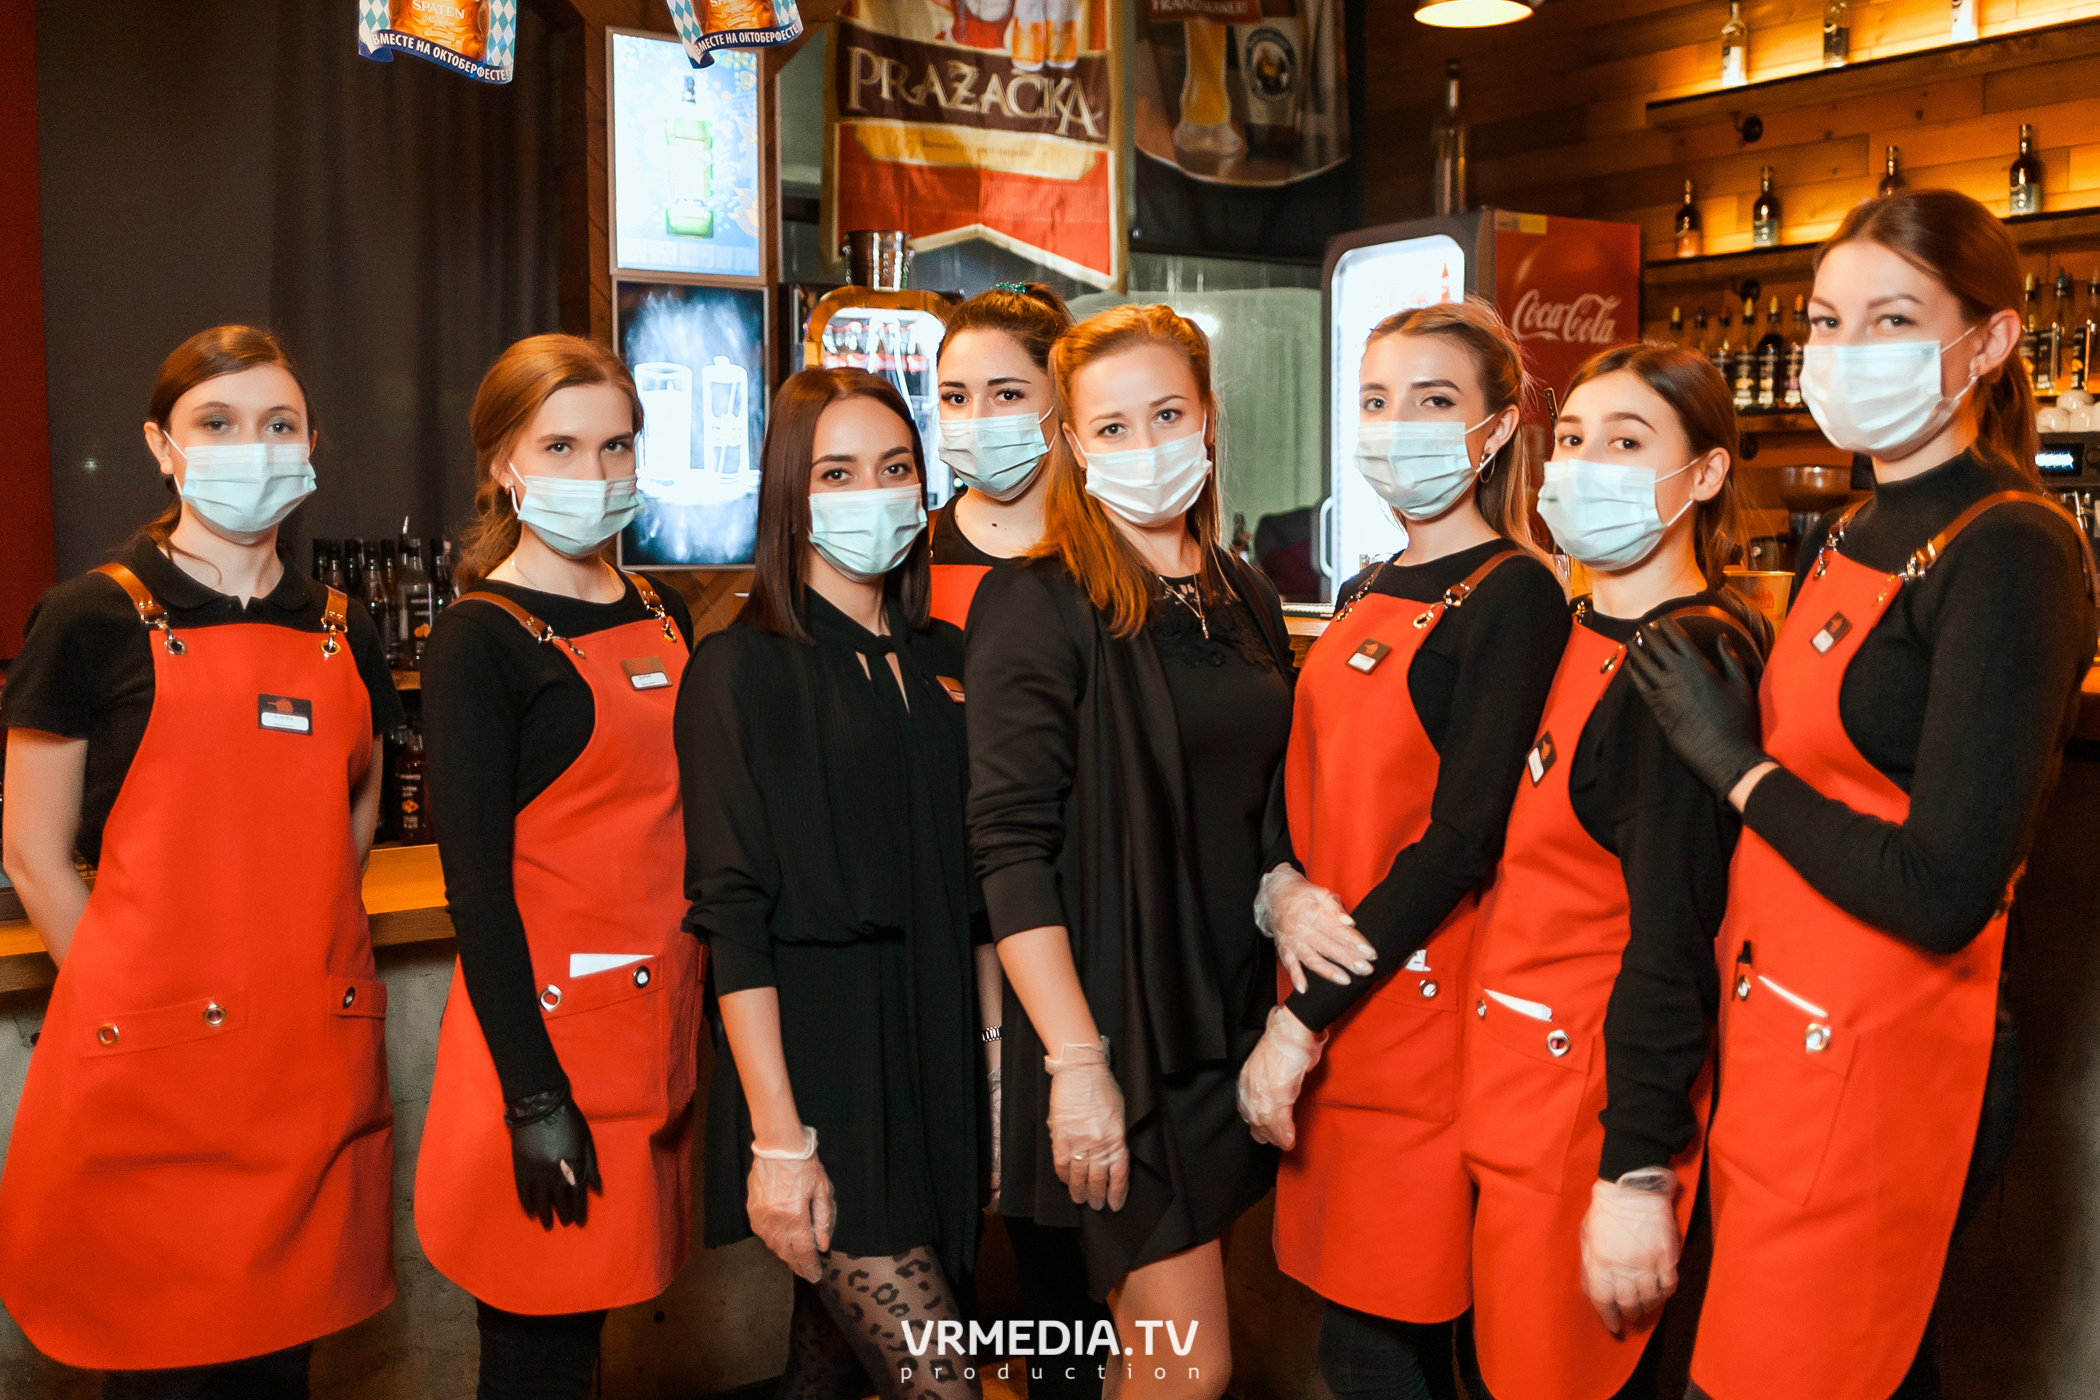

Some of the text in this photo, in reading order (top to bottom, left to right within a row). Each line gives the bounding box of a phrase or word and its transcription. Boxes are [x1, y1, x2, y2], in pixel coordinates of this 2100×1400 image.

[412, 0, 465, 19] SPATEN
[694, 22, 800, 55] ВМЕСТЕ НА ОКТОБЕРФЕСТЕ!
[372, 33, 510, 81] ВМЕСТЕ НА ОКТОБЕРФЕСТЕ!
